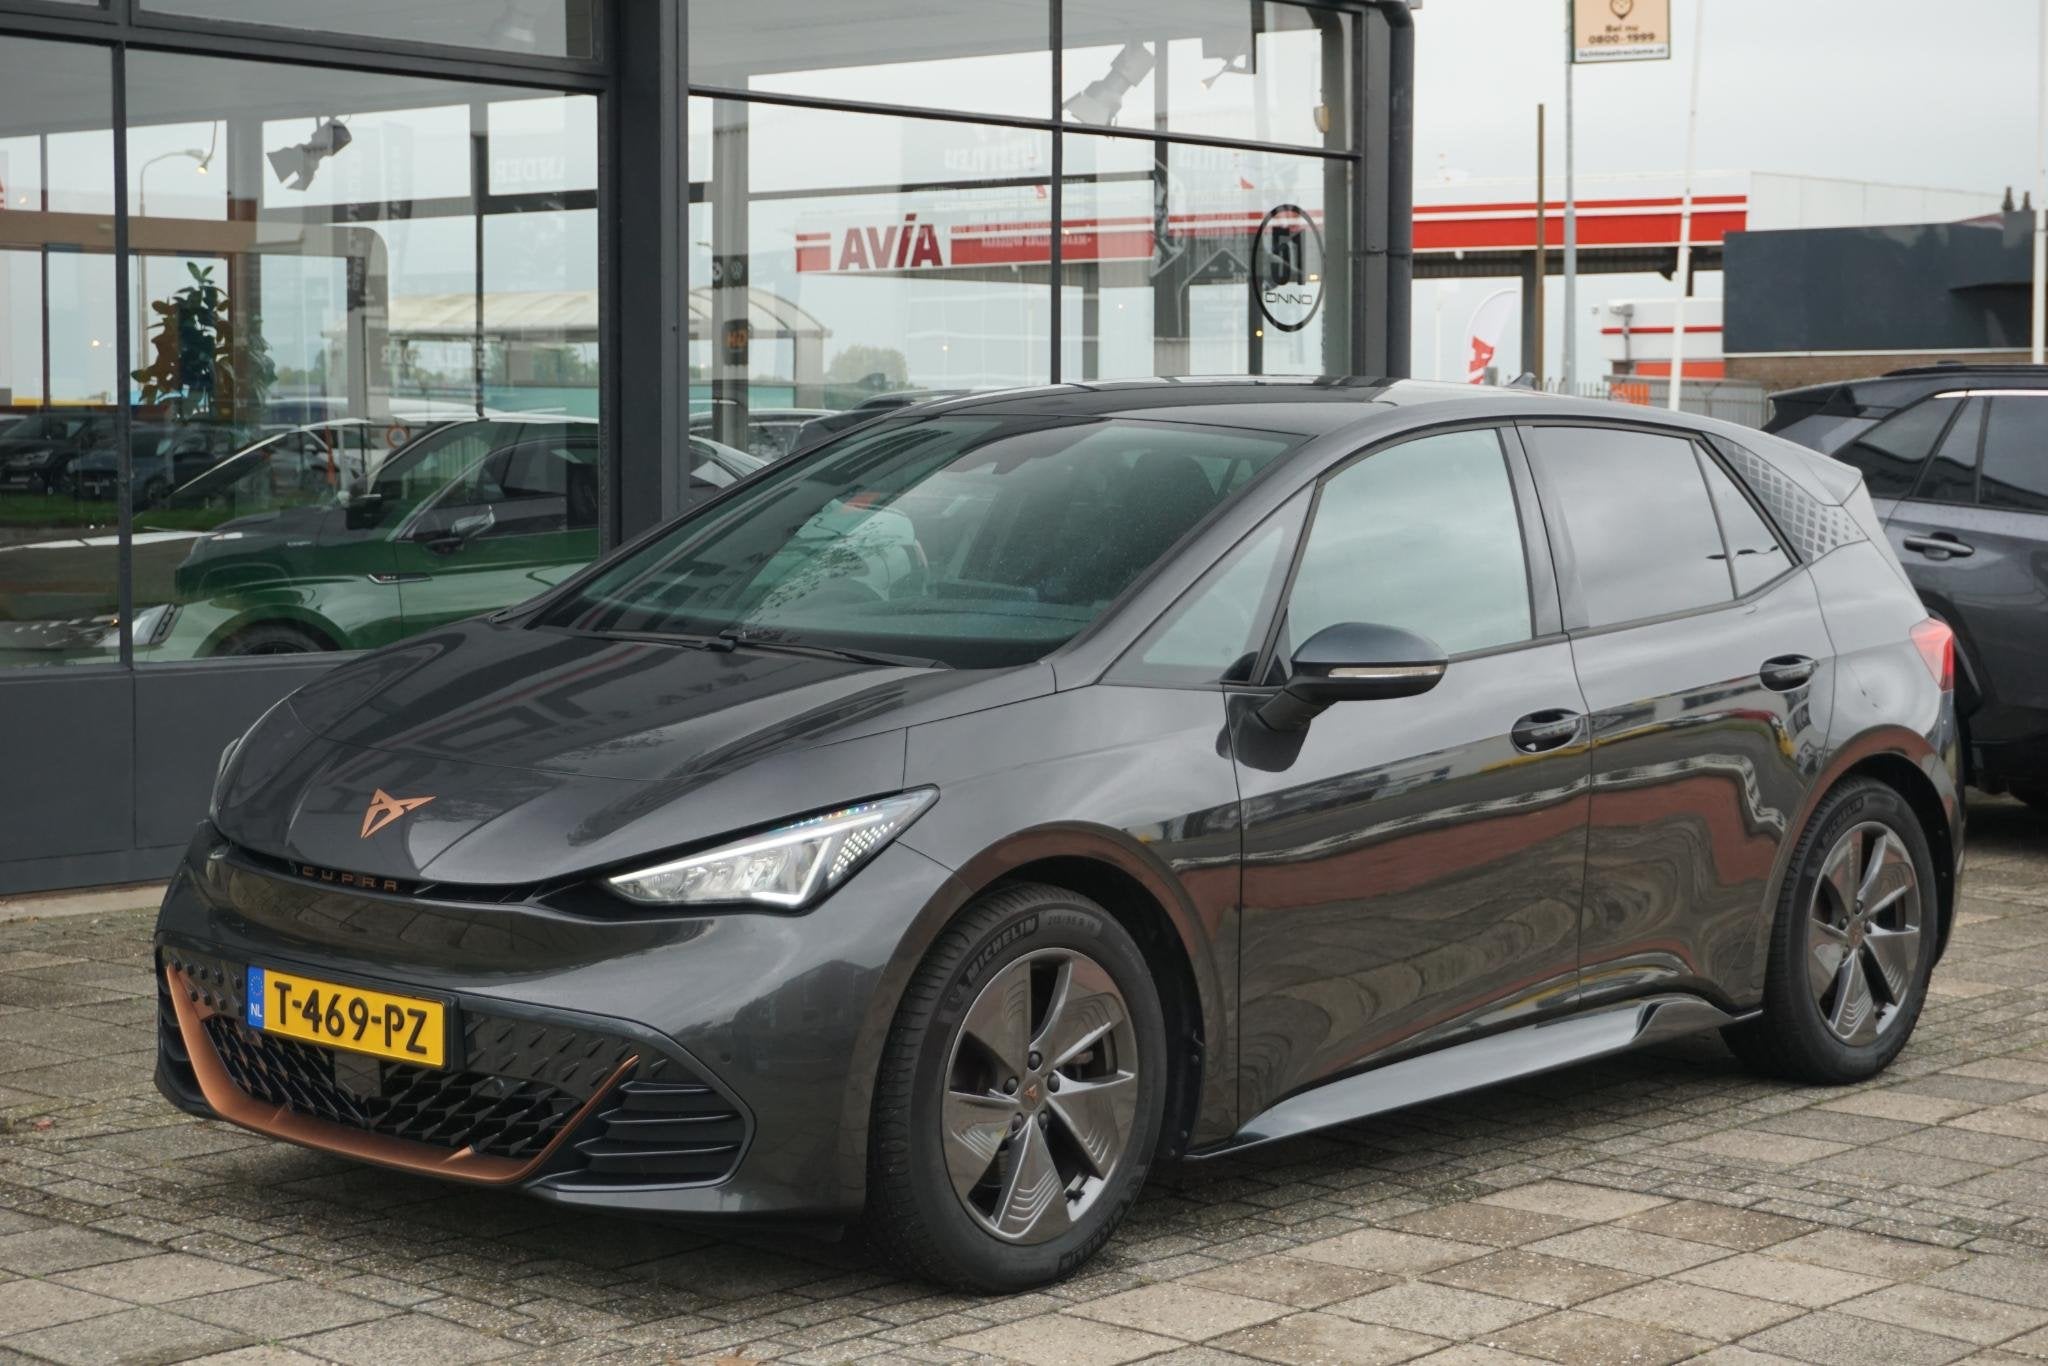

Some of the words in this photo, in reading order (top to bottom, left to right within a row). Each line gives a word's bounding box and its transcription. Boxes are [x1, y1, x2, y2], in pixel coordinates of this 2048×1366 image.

[302, 866, 397, 891] CUPRA
[966, 916, 1037, 984] MICHELIN
[250, 1003, 263, 1018] NL
[274, 980, 427, 1055] T-469-PZ
